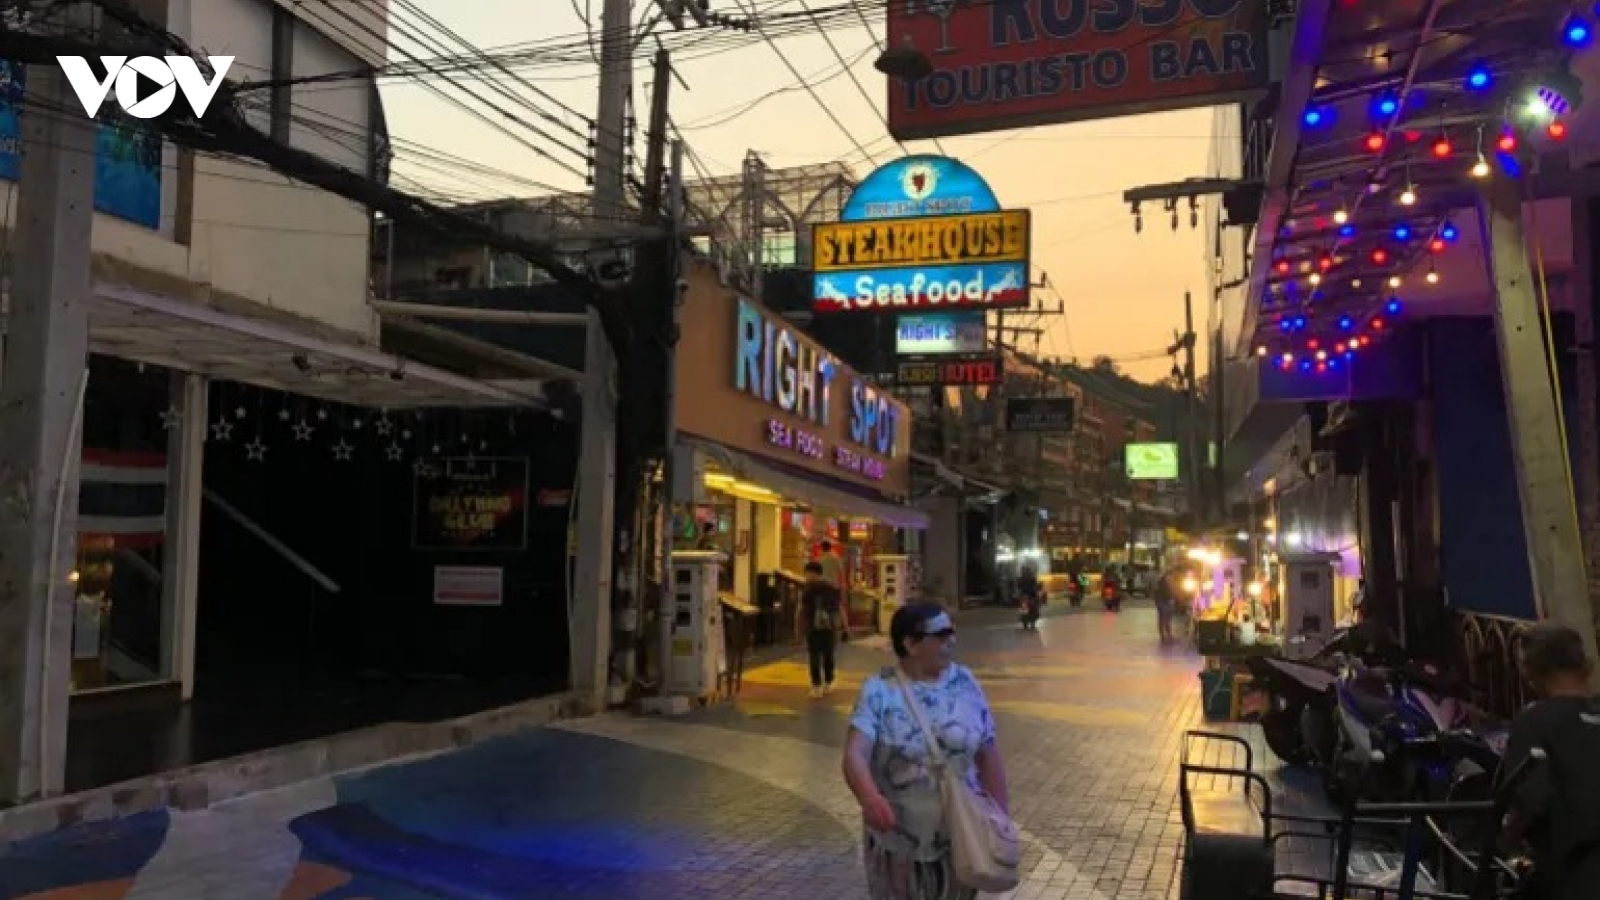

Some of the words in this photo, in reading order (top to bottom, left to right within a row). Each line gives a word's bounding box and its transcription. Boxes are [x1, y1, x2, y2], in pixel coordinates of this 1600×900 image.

[901, 48, 1130, 112] TOURISTO
[1149, 31, 1256, 83] BAR
[855, 268, 984, 307] Seafood
[736, 298, 839, 428] RIGHT
[850, 377, 899, 459] SPOT
